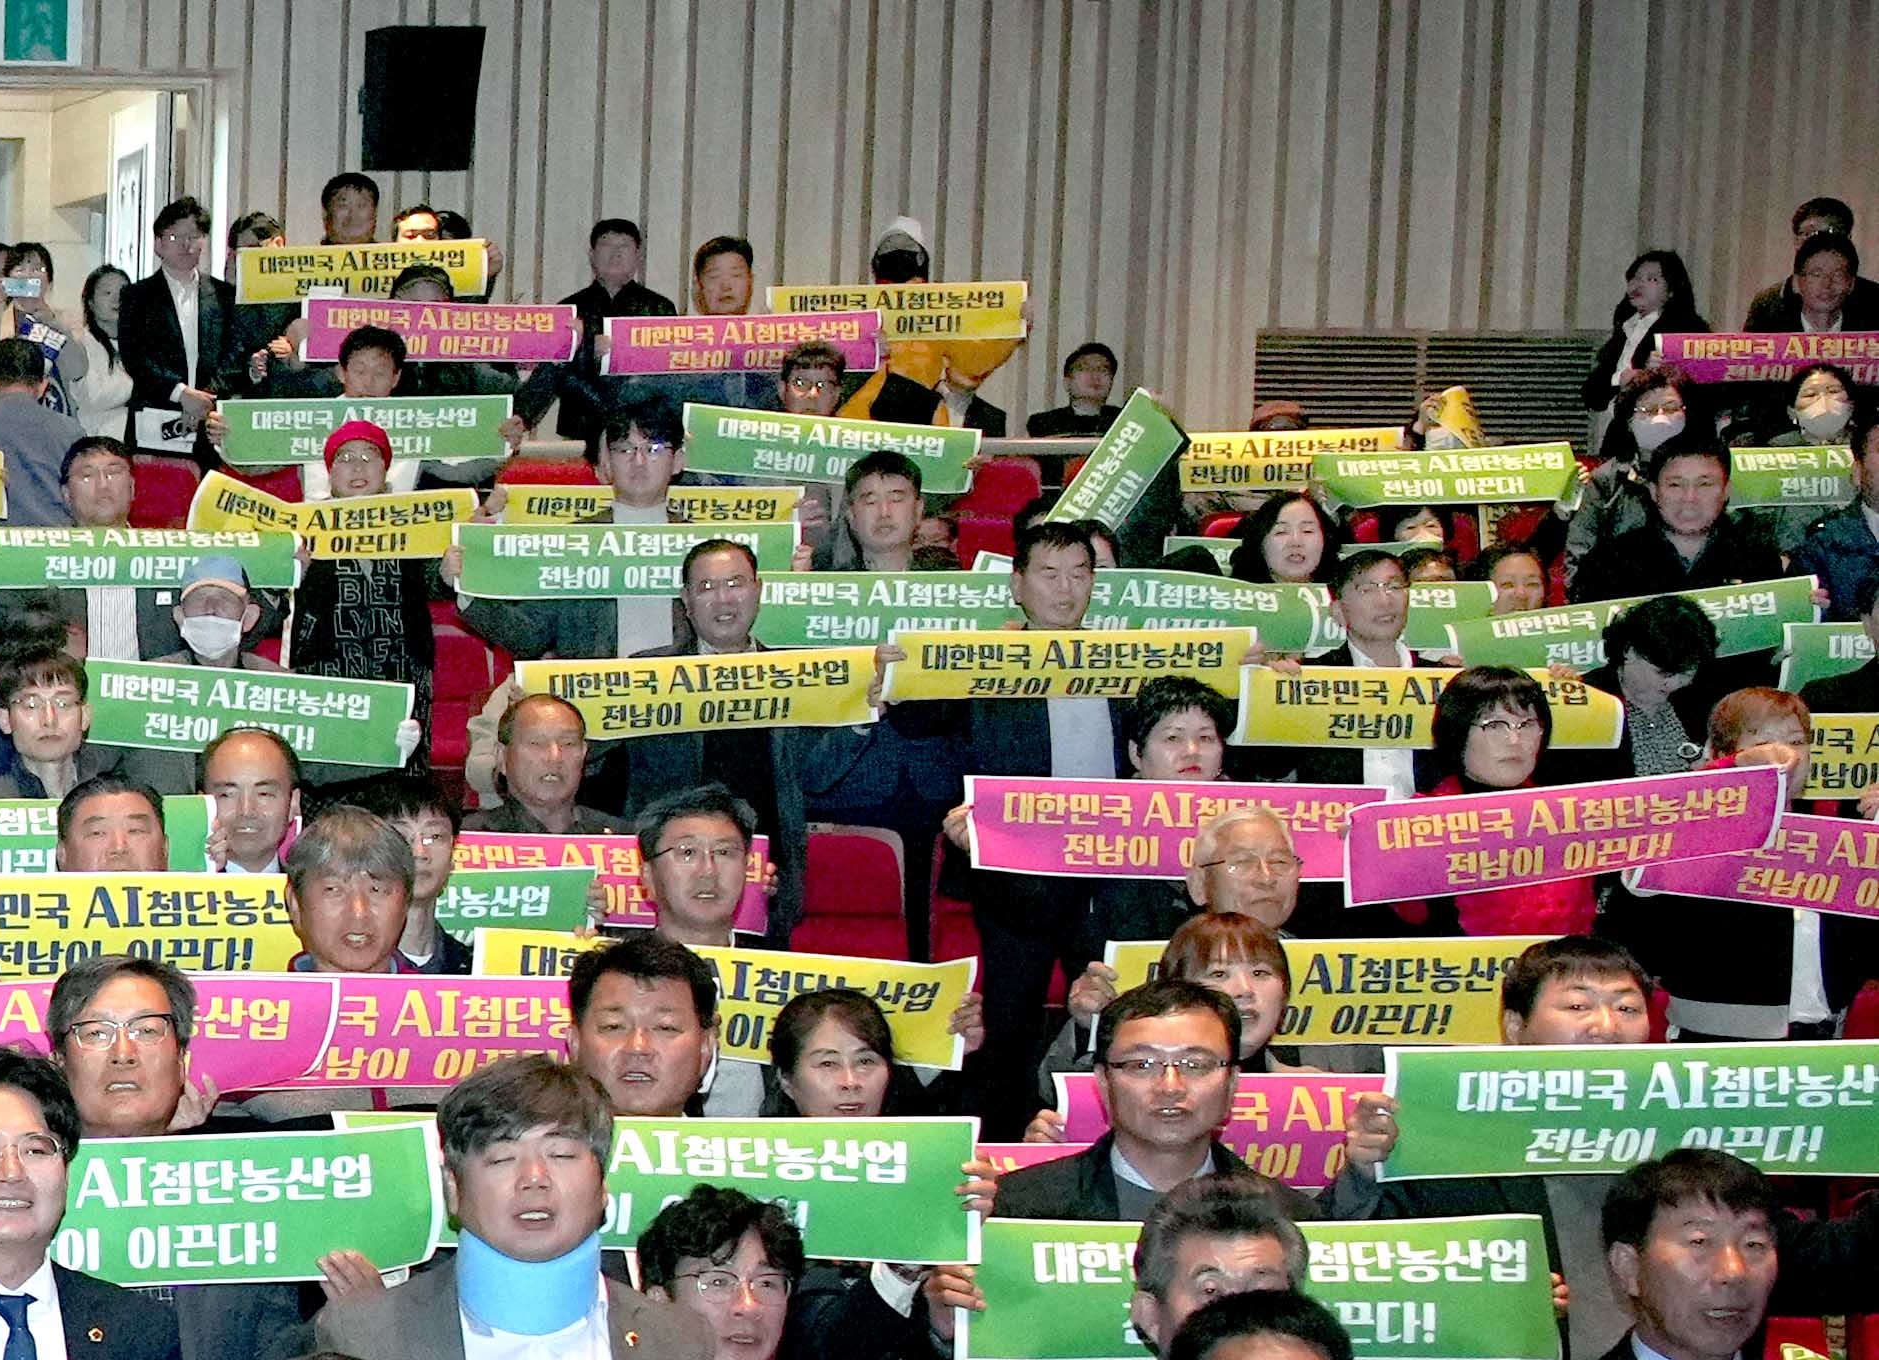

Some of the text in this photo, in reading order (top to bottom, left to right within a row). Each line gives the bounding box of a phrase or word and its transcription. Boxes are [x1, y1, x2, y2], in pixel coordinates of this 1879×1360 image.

[789, 289, 1004, 313] 대한민국 AI첨단농산업
[630, 320, 860, 347] 대한민국 AI첨단농산업
[251, 409, 334, 431] 대한민국
[717, 417, 946, 458] 대한민국 AI첨단농산업
[1336, 451, 1565, 477] 대한민국 AI첨단농산업
[1733, 452, 1820, 472] 대한민국
[1454, 476, 1526, 497] 이끈다!
[306, 497, 455, 532] AI첨단농산업
[330, 532, 407, 554] 이끈다!
[493, 533, 590, 557] 대한민국
[45, 555, 116, 580] 전남이
[760, 581, 860, 606] 대한민국
[921, 639, 1224, 671] 대한민국 AI첨단농산업
[100, 672, 371, 720] 대한민국 AI첨단농산업
[549, 659, 850, 700] 대한민국 AI첨단농산업
[1275, 679, 1390, 706] 대한민국
[145, 712, 219, 742] 전남이
[601, 696, 790, 731] 전남이 이끈다!
[1003, 791, 1133, 827] 대한민국
[1376, 785, 1748, 850] 대한민국 AI첨단농산업
[1062, 833, 1159, 867] 전남이
[1445, 831, 1674, 885] 전남이 이끈다!
[1330, 1003, 1453, 1036] 이끈다!
[1456, 1068, 1628, 1112] 대한민국
[608, 1128, 908, 1184] AI첨단농산업
[1525, 1127, 1657, 1163] 전남이
[75, 1153, 372, 1209] AI첨단농산업
[127, 1221, 277, 1269] 이끈다!
